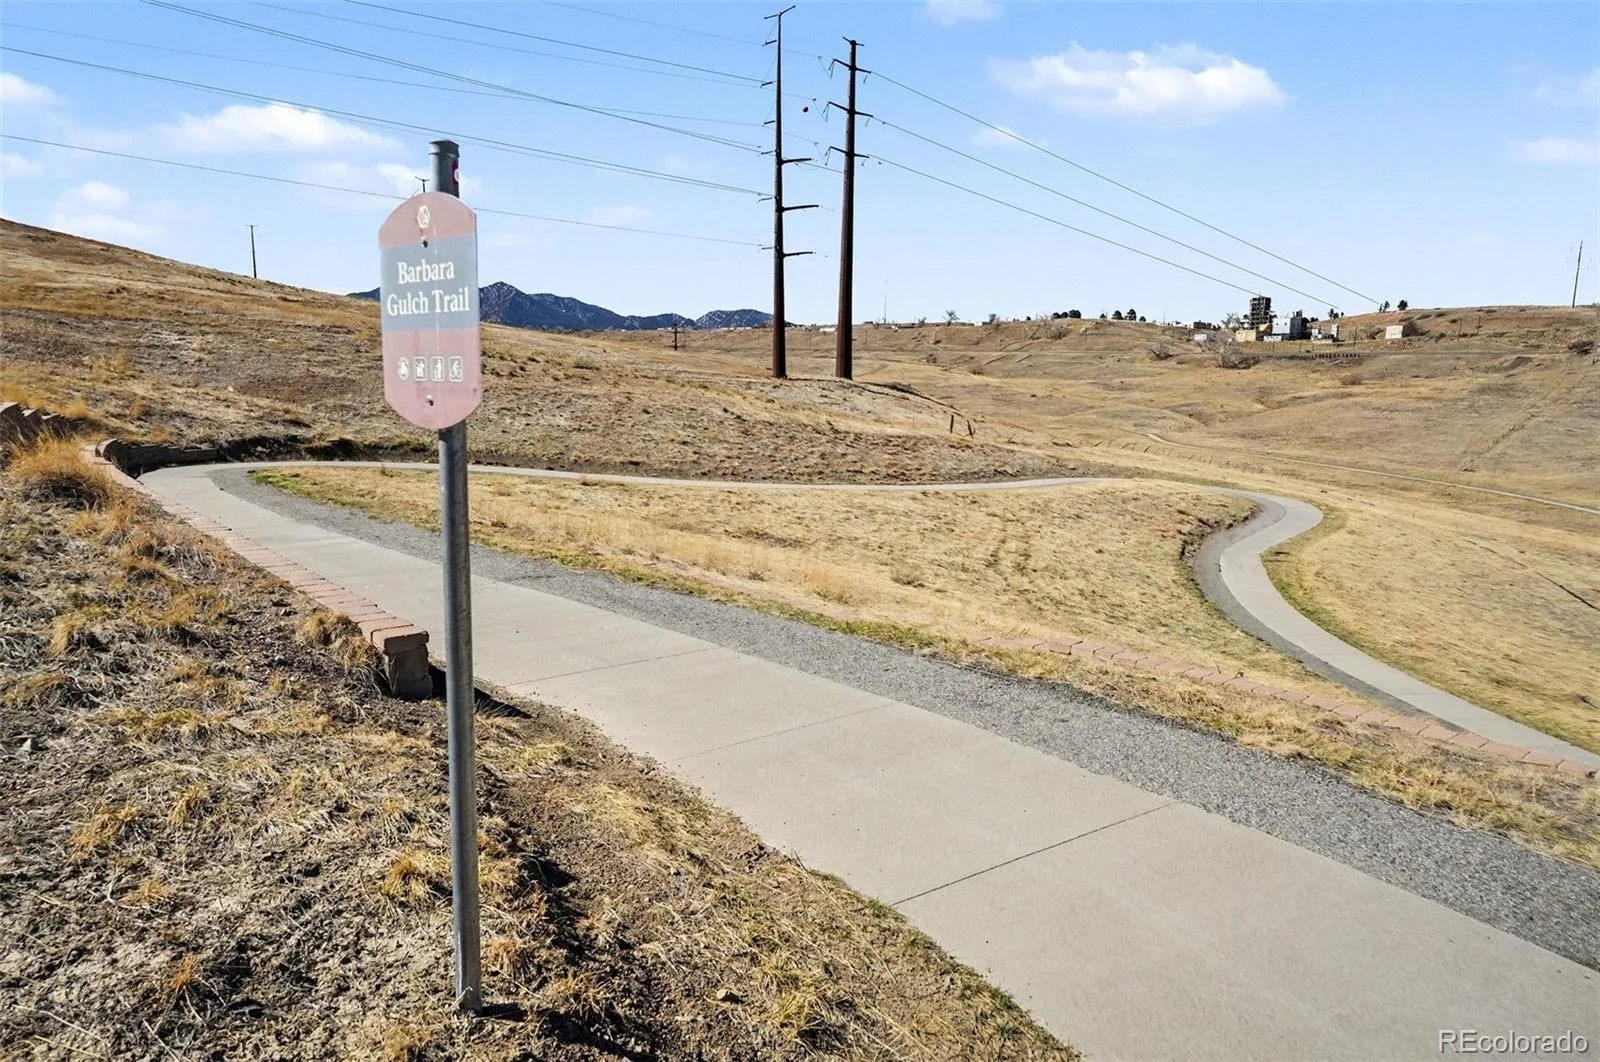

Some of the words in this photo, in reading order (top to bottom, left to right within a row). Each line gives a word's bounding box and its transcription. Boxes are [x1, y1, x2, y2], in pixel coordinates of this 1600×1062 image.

[397, 259, 454, 284] Barbara
[387, 291, 430, 315] Gulch
[432, 287, 470, 312] Trail
